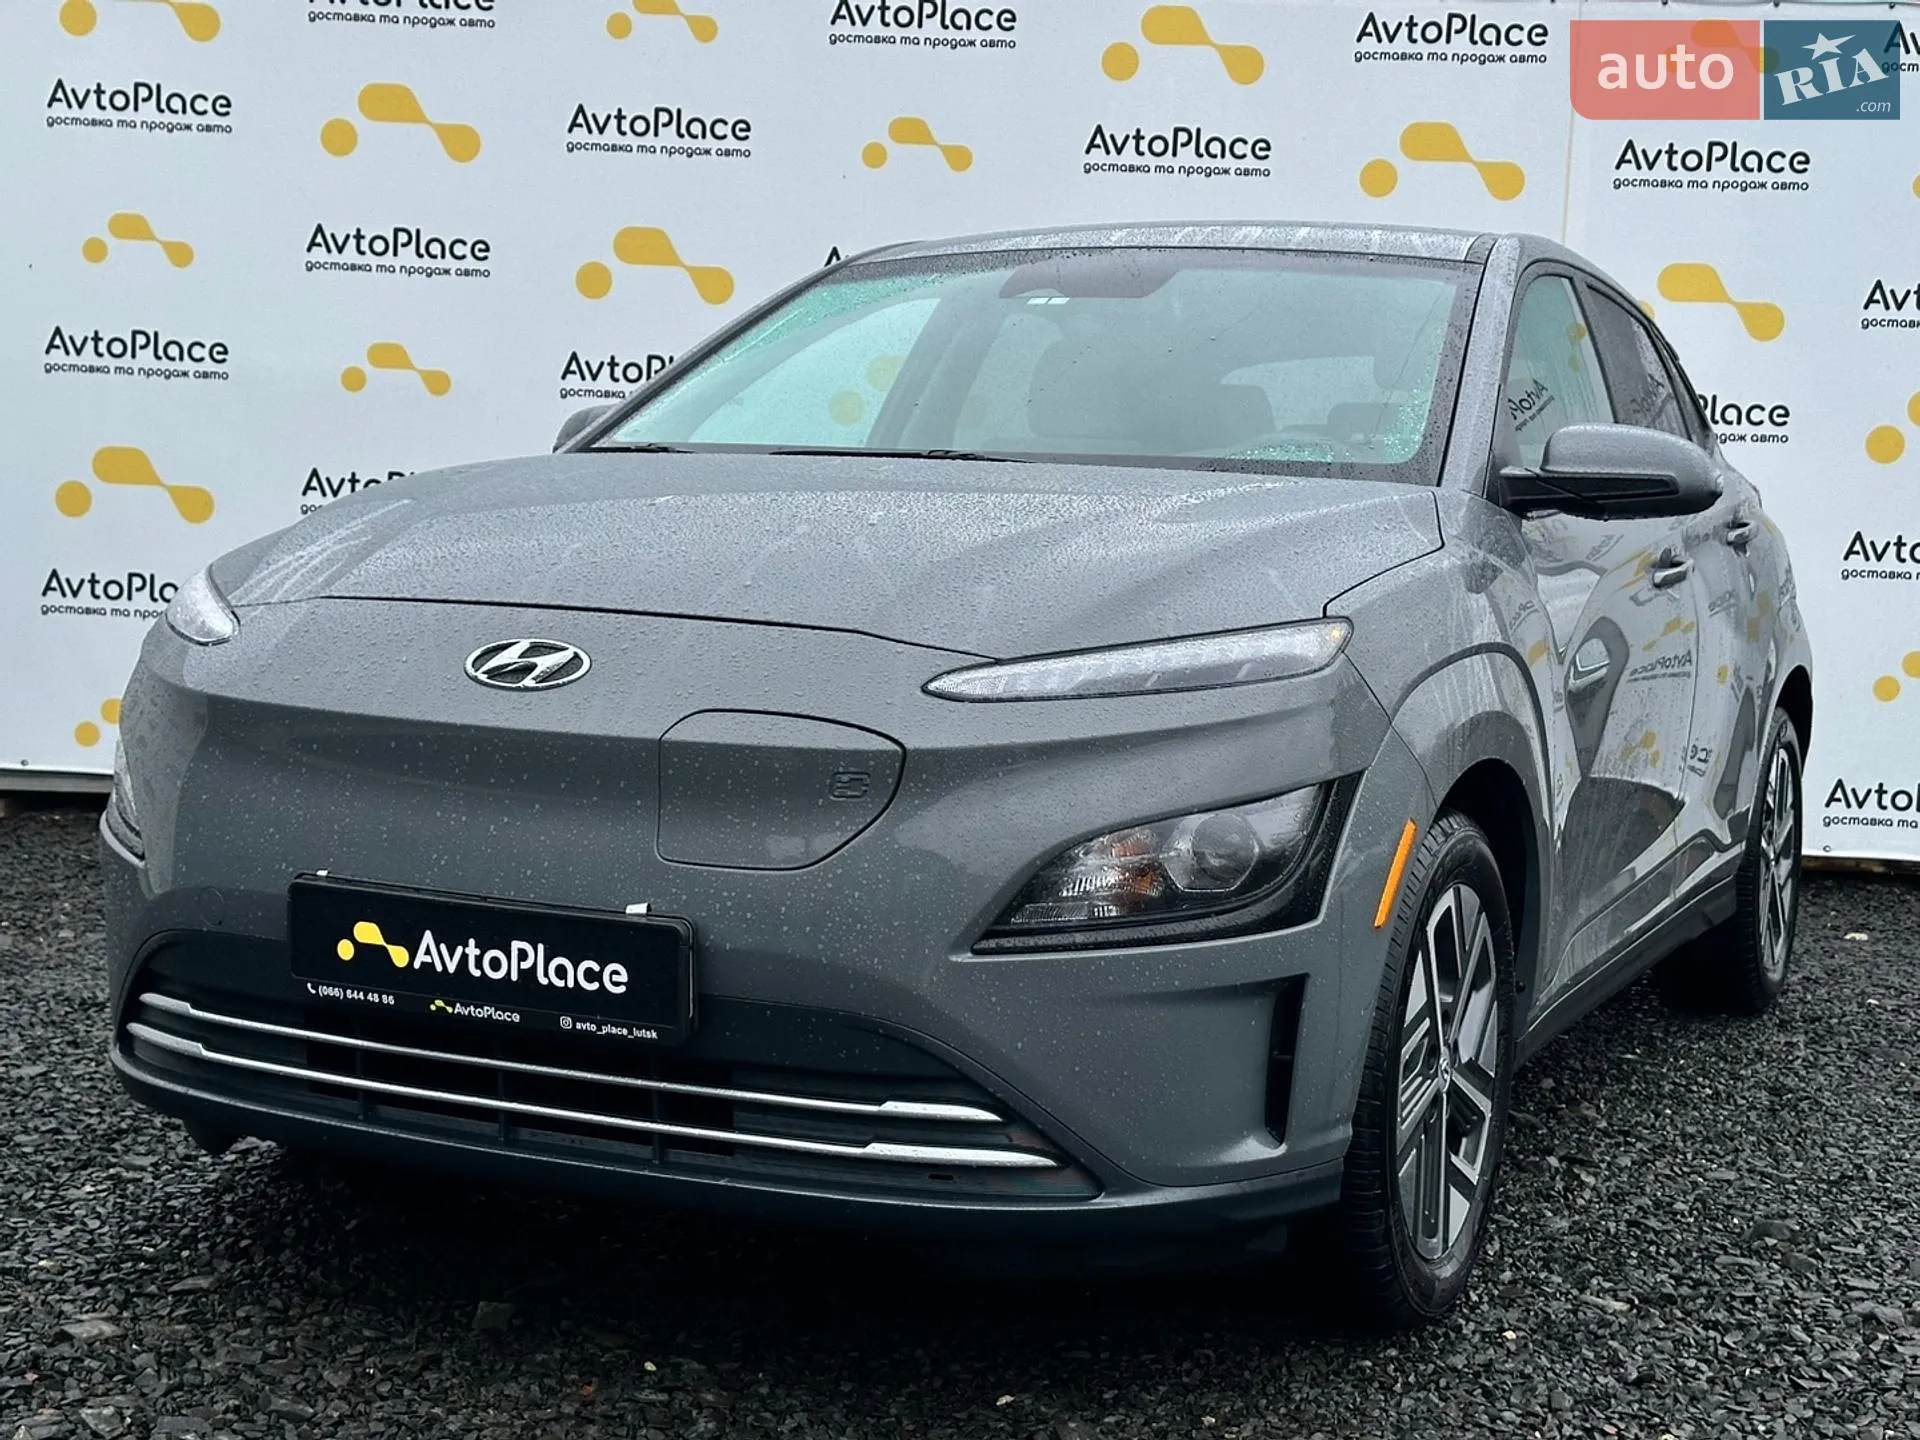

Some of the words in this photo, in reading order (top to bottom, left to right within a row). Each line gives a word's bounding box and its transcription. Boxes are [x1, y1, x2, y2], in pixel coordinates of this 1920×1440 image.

[308, 11, 376, 23] доставка
[380, 15, 400, 24] та
[403, 15, 456, 29] продаж
[459, 18, 496, 29] авто
[830, 0, 1017, 32] AvtoPlace
[1356, 12, 1549, 47] AvtoPlace
[829, 33, 897, 46] доставка
[900, 36, 921, 46] та
[924, 37, 977, 50] продаж
[980, 39, 1017, 49] авто
[1354, 51, 1424, 63] доставка
[1427, 52, 1448, 62] та
[1452, 53, 1506, 65] продаж
[1509, 54, 1547, 64] авто
[46, 78, 233, 117] AvtoPlace
[46, 115, 114, 128] доставка
[117, 119, 137, 129] та
[140, 121, 193, 134] продаж
[196, 123, 233, 134] авто
[567, 104, 752, 142] AvtoPlace
[566, 142, 634, 153] доставка
[637, 145, 657, 154] та
[660, 146, 712, 159] продаж
[715, 148, 751, 158] авто
[1085, 124, 1272, 161] AvtoPlace
[1615, 139, 1811, 174] AvtoPlace
[1083, 162, 1151, 175] доставка
[1154, 164, 1175, 174] та
[1178, 165, 1231, 178] продаж
[1234, 167, 1271, 178] авто
[1613, 177, 1684, 190] доставка
[1687, 179, 1708, 189] та
[1712, 180, 1768, 193] продаж
[1771, 182, 1809, 191] авто
[305, 223, 491, 262] AvtoPlace
[305, 260, 373, 272] доставка
[376, 264, 396, 274] та
[399, 266, 451, 279] продаж
[454, 267, 491, 278] авто
[44, 325, 229, 365] AvtoPlace
[44, 362, 111, 374] доставка
[114, 366, 135, 376] та
[138, 367, 190, 380] продаж
[193, 370, 229, 381] авто
[561, 351, 674, 384] AvtoP
[560, 387, 626, 400] доставка
[1750, 434, 1789, 444] авто
[1841, 568, 1912, 581] доставка
[40, 604, 107, 617] доставка
[110, 607, 131, 618] та
[1824, 778, 1920, 813] Avto
[1823, 816, 1894, 828] доставка
[413, 929, 629, 994] AvtoPlace
[454, 1003, 521, 1023] AvtoPlace
[576, 1021, 658, 1040] avto_place_lutsk
